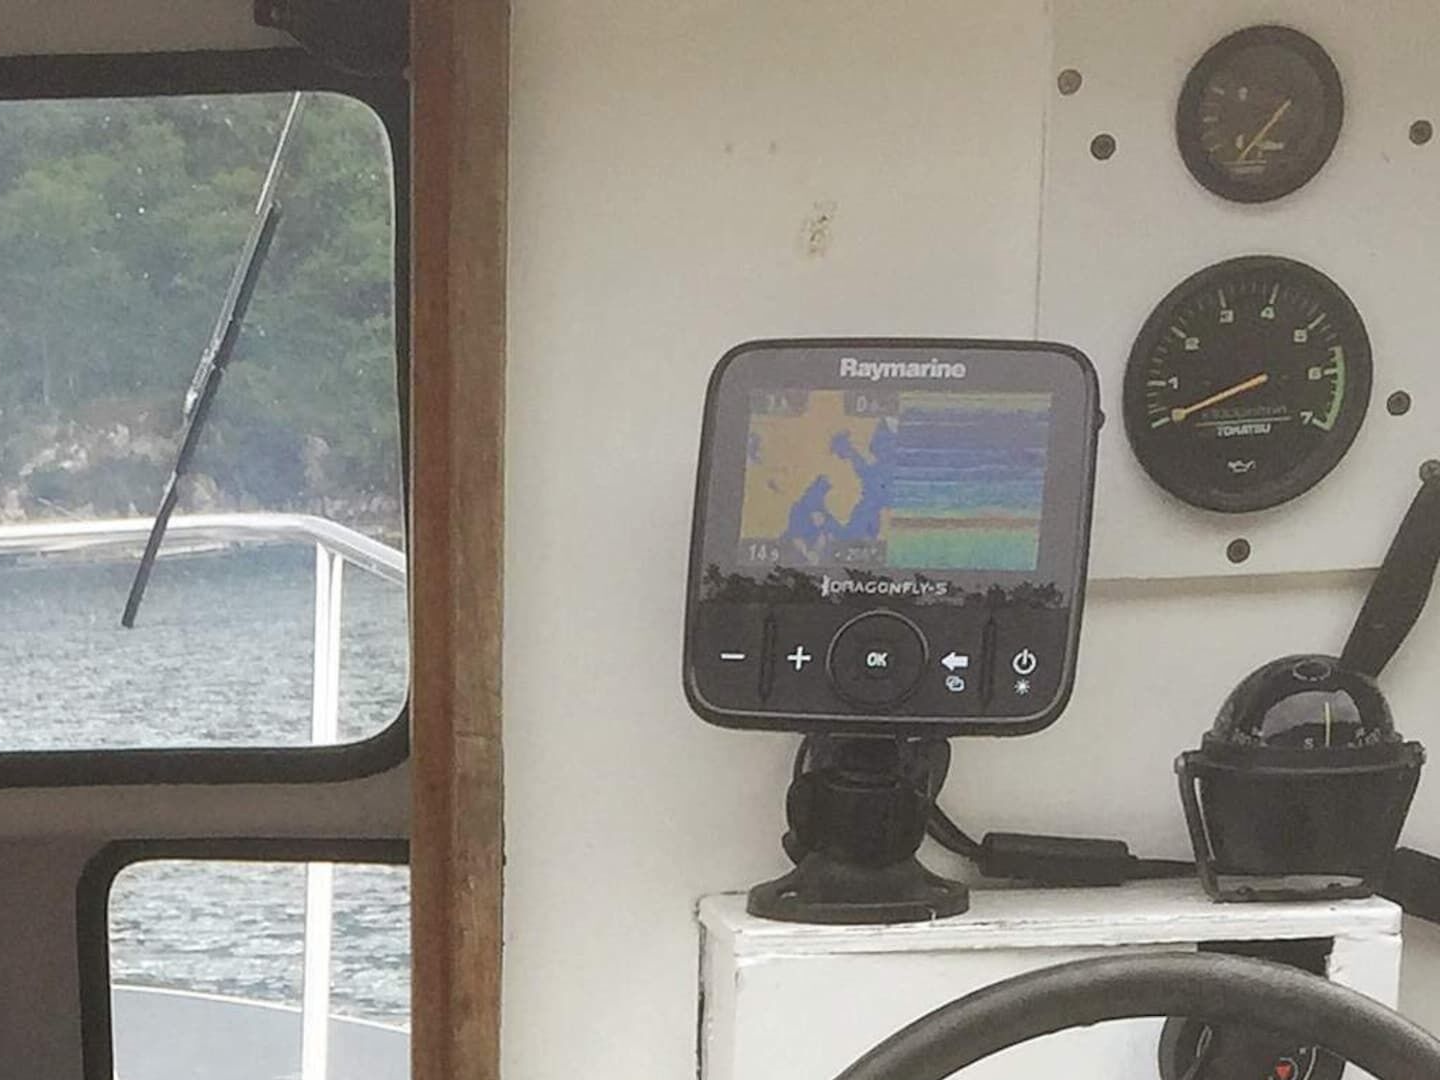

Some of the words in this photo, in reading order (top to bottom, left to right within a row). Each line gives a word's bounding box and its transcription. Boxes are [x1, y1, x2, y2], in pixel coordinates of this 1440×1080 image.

[1260, 307, 1275, 320] 4
[840, 357, 966, 381] Raymarine
[1167, 376, 1179, 389] 1
[1299, 410, 1313, 425] 7
[866, 652, 888, 668] OK
